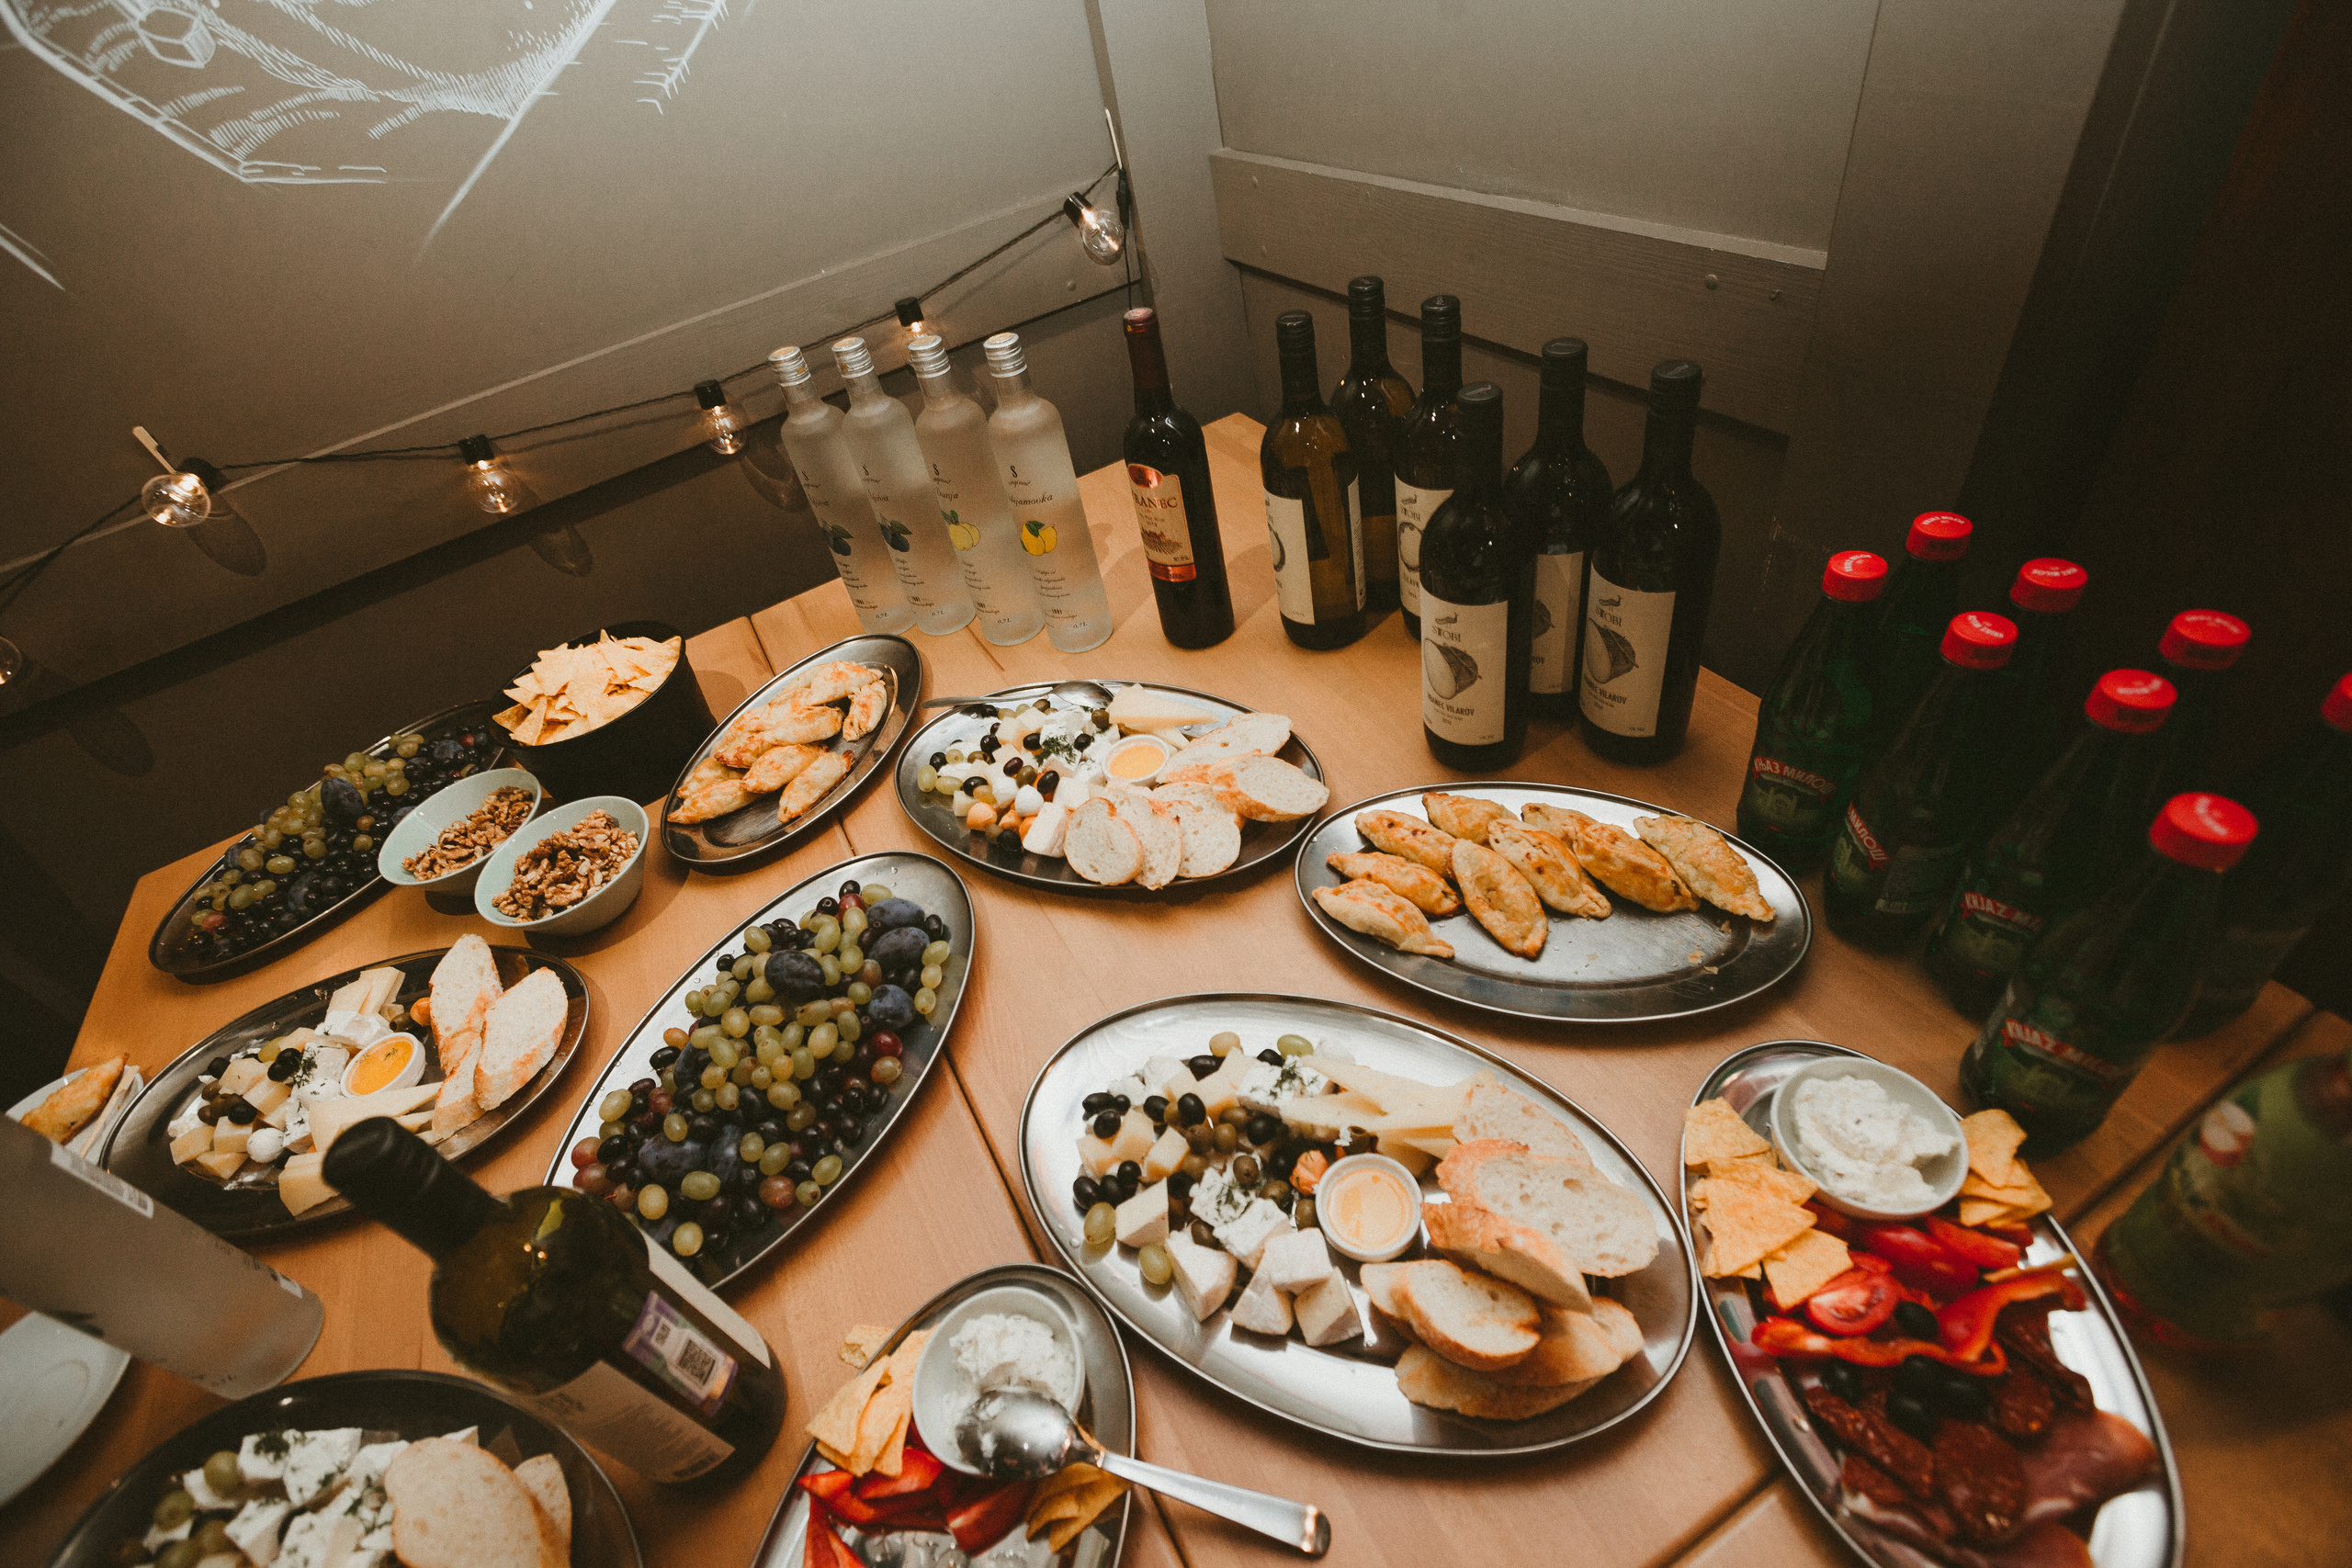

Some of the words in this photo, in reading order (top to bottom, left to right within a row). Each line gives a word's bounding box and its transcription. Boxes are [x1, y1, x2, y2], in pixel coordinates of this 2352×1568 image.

[1595, 605, 1623, 627] STOBI
[1431, 625, 1462, 643] STOBI
[1599, 688, 1628, 705] VILAROV
[1446, 704, 1476, 716] VILAROV
[1754, 757, 1781, 774] КЊАЗ
[1782, 766, 1837, 795] МИЛОШ
[1964, 892, 2007, 917] KNJAZ
[2007, 1020, 2056, 1053] KNJAZ
